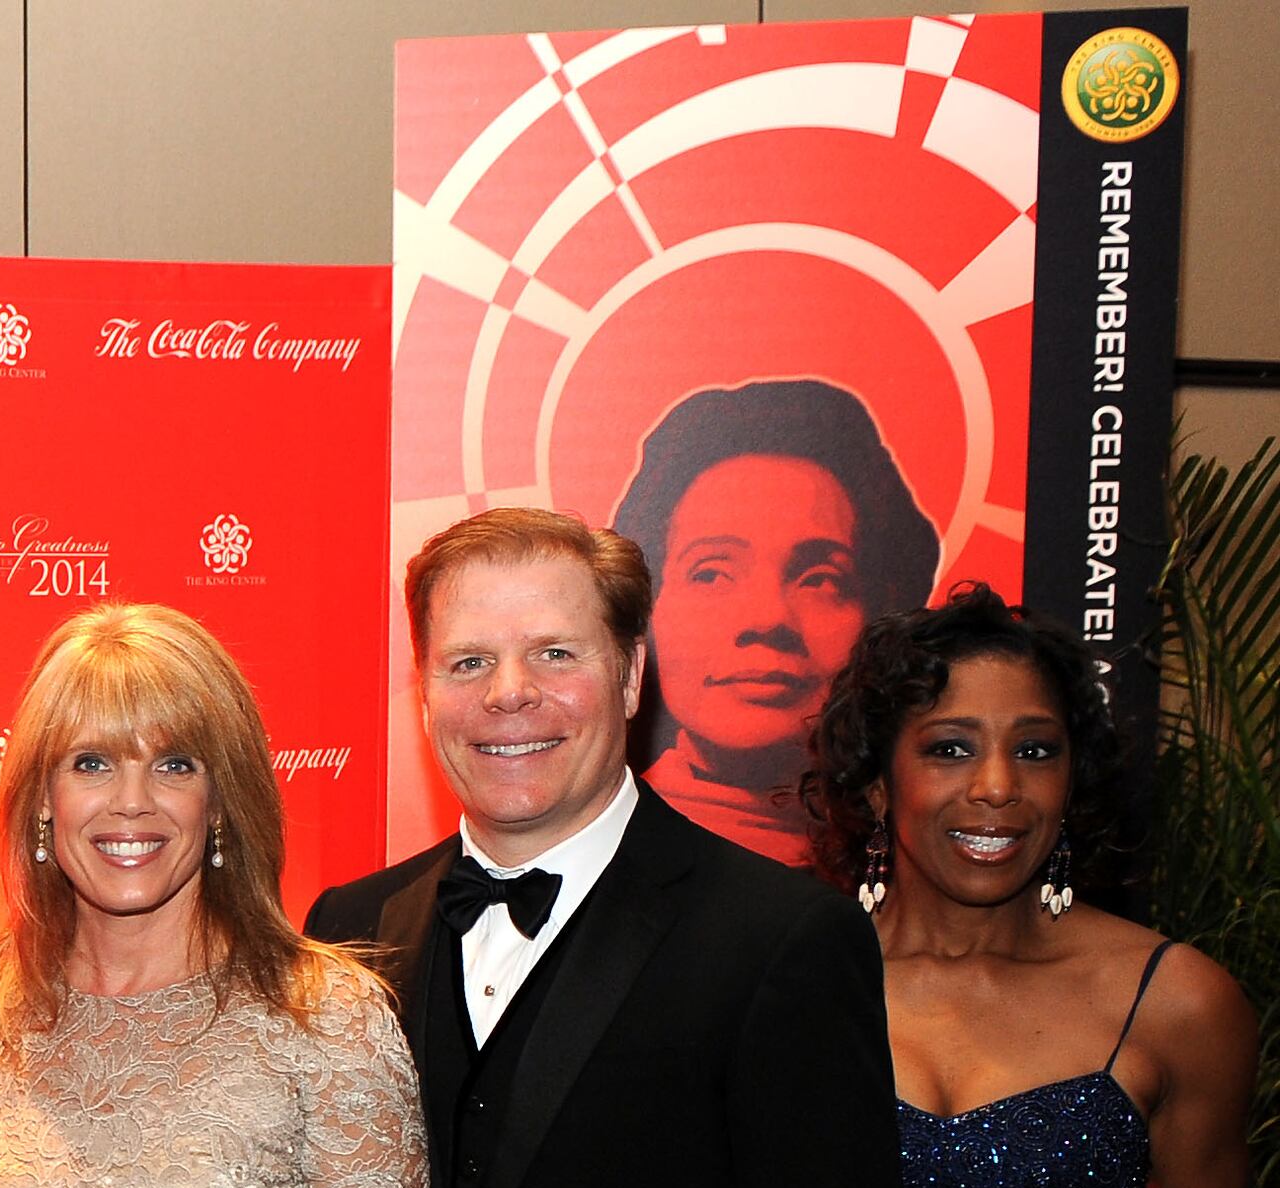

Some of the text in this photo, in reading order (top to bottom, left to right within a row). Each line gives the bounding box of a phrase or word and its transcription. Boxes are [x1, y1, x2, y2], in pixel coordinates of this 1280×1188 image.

[1093, 160, 1133, 393] REMEMBER!
[95, 318, 141, 358] The
[252, 322, 361, 373] Company
[8, 367, 48, 380] CENTER
[7, 513, 110, 584] Greatness
[1083, 404, 1124, 642] CELEBRATE!
[29, 559, 110, 597] 2014
[184, 574, 268, 587] THE KING CENTER
[267, 734, 351, 782] mpany
